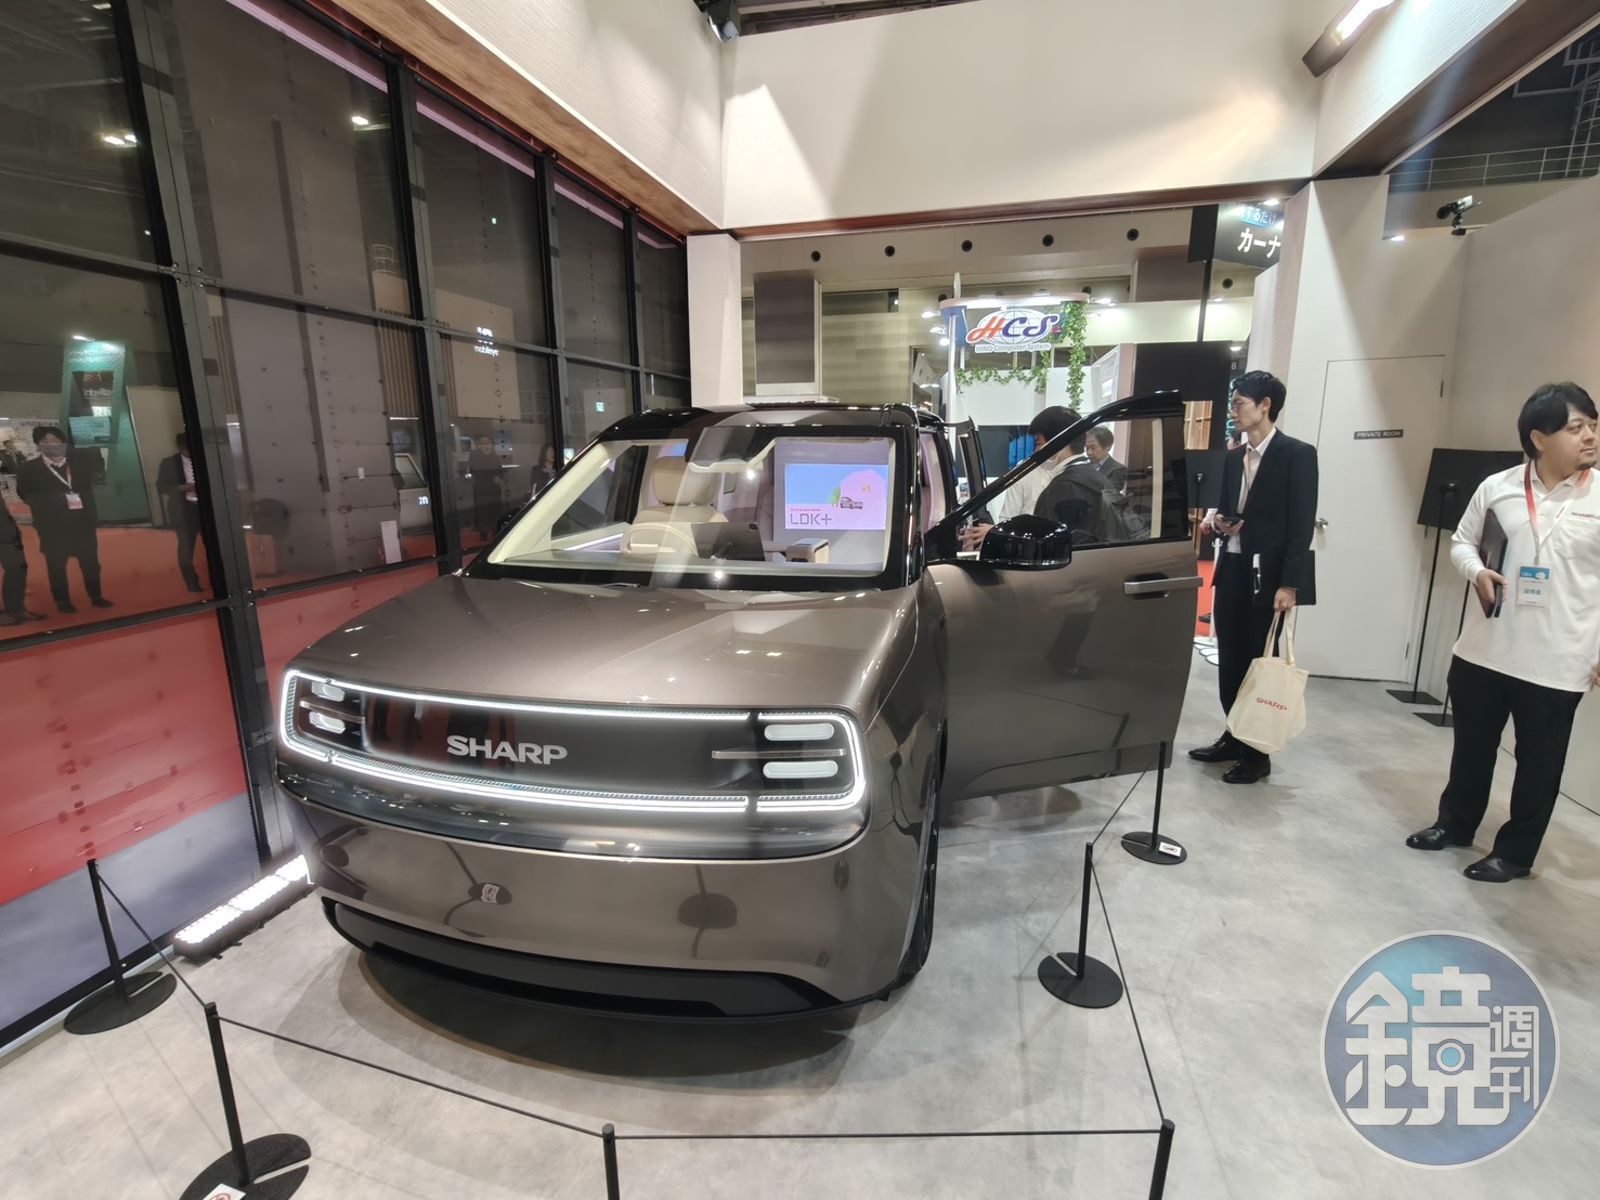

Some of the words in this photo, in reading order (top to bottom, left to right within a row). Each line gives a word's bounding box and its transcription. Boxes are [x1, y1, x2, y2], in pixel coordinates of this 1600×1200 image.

[967, 315, 1059, 342] HCS
[994, 343, 1026, 353] Computer
[1026, 342, 1051, 352] System
[790, 513, 832, 525] LDK+
[1256, 697, 1287, 710] SHARP
[446, 734, 568, 766] SHARP
